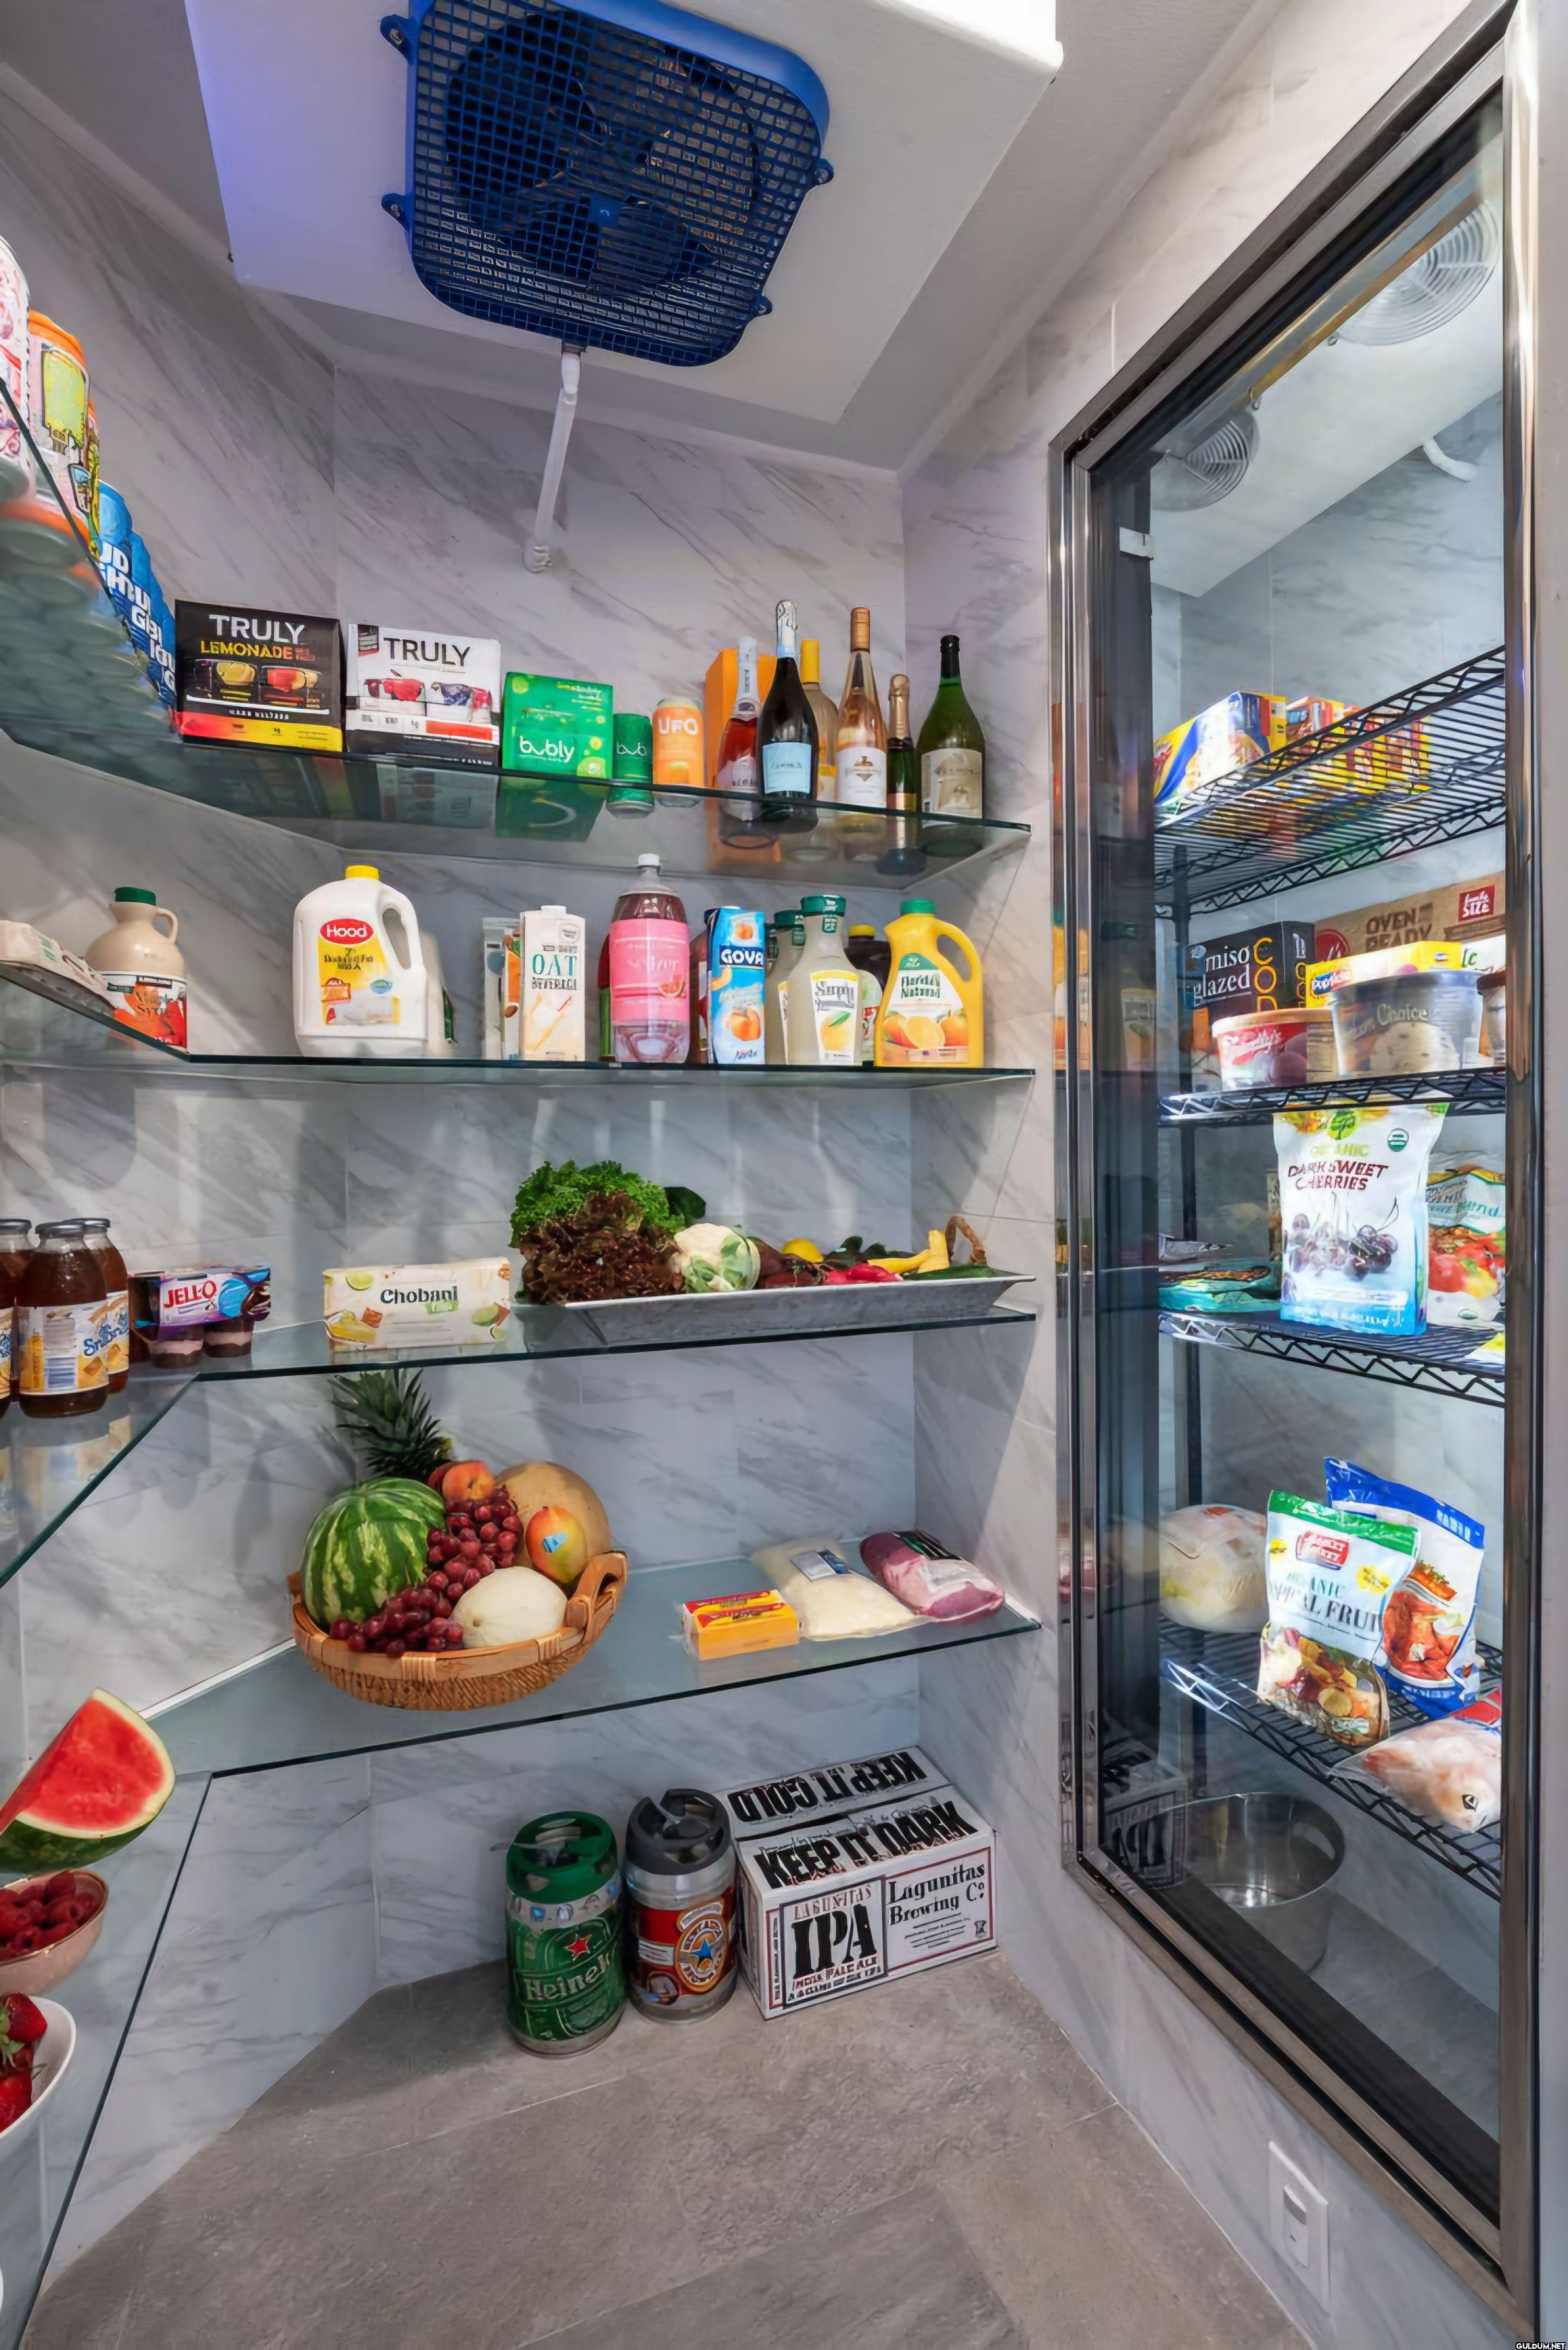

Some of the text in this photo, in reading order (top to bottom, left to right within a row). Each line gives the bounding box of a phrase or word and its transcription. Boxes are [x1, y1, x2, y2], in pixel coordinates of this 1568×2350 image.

[209, 614, 305, 644] TRULY
[201, 640, 293, 659] LEMONADE
[384, 638, 470, 666] TRULY
[520, 735, 574, 763] bubly
[327, 925, 367, 938] Hood
[1366, 907, 1416, 934] OVEN
[532, 954, 577, 976] OAT
[1205, 946, 1250, 972] miso
[1193, 963, 1250, 1007] glazed
[1329, 1160, 1389, 1178] SWEET
[381, 1286, 458, 1304] Chobani
[753, 1801, 978, 1889] KEEP IT DARK
[889, 1864, 985, 1903] Lagunitas
[791, 1903, 878, 1979] IPA
